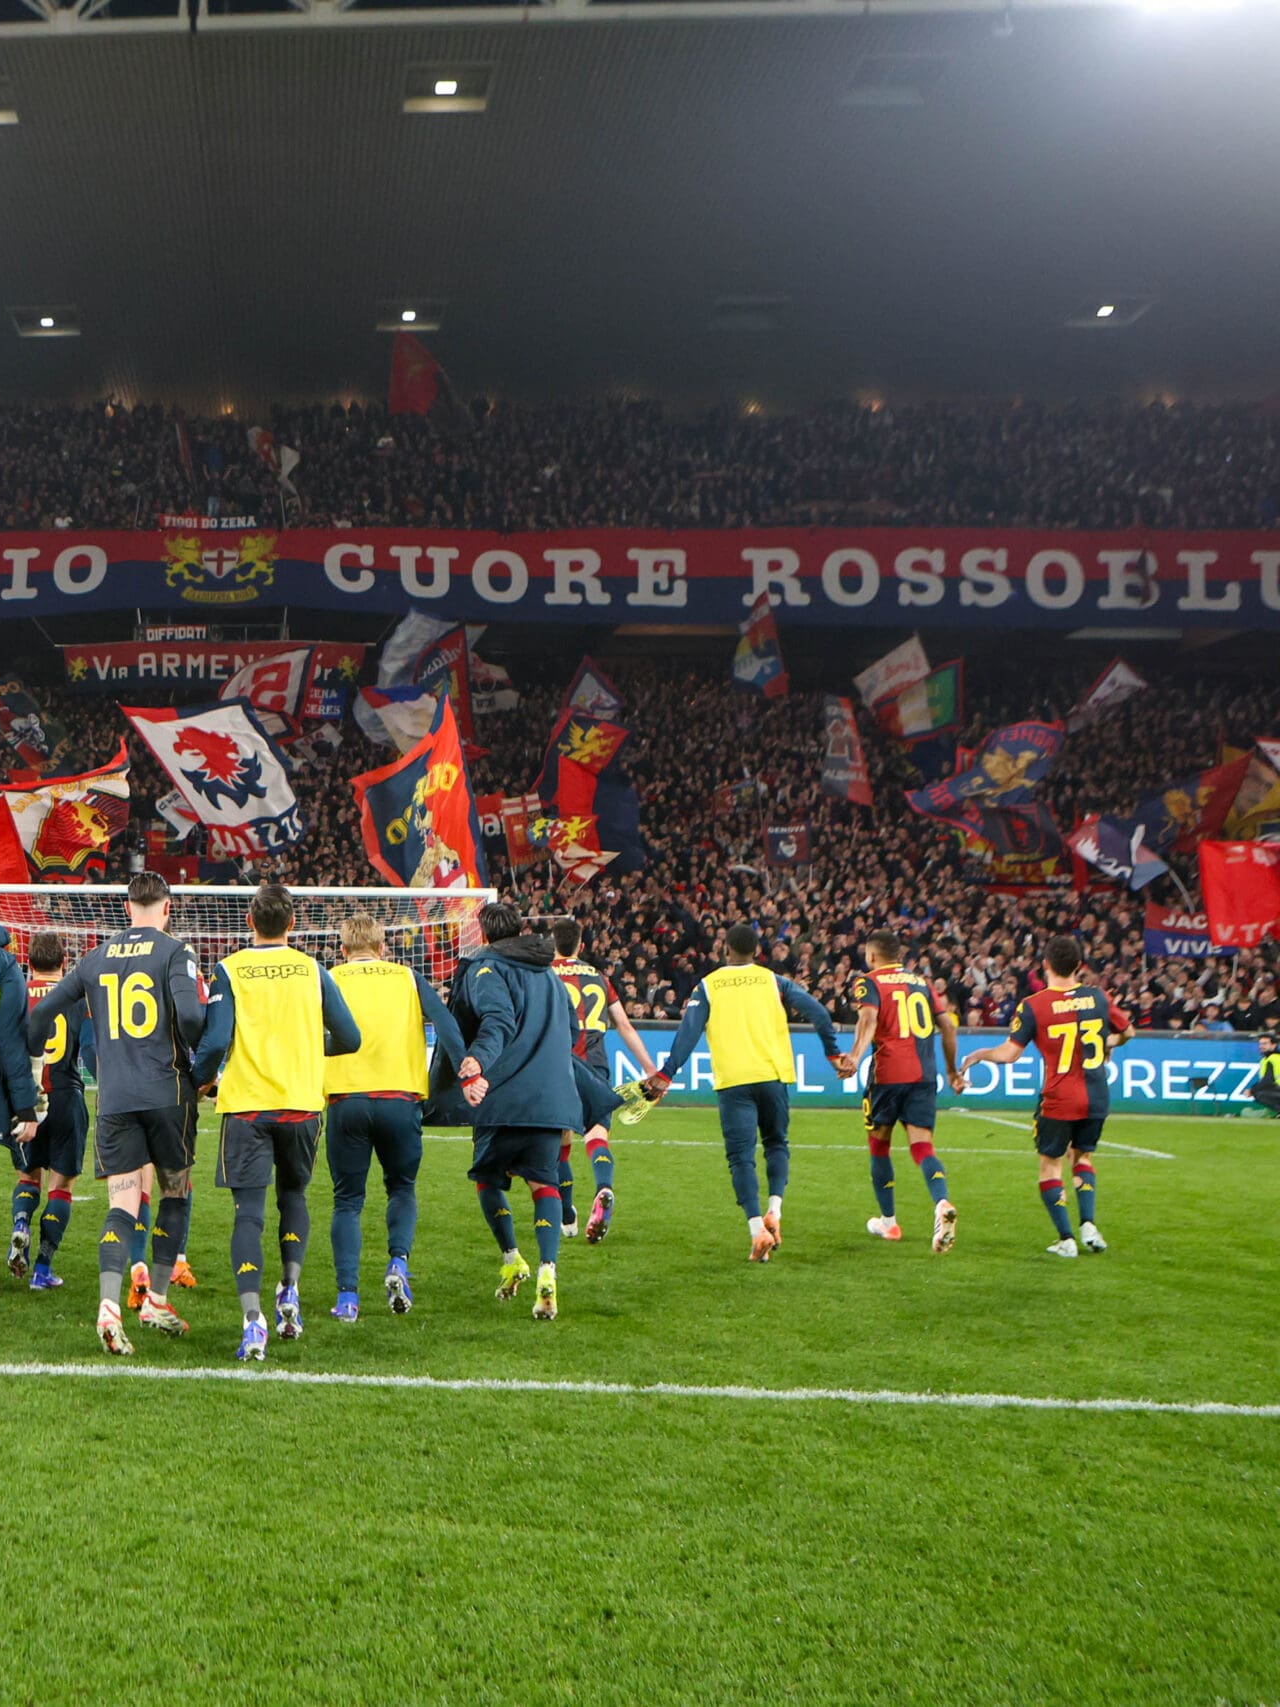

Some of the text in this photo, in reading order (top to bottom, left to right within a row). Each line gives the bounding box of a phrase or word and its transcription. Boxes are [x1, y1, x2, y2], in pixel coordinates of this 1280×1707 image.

[220, 515, 257, 528] ZENA
[323, 543, 688, 607] CUORE
[146, 626, 207, 642] DIFFIDATI
[106, 941, 154, 958] BIJLOW
[236, 964, 309, 979] Kappa
[713, 975, 769, 990] Kappa
[99, 972, 158, 1040] 16
[892, 990, 934, 1039] 10
[1047, 1018, 1105, 1074] 73
